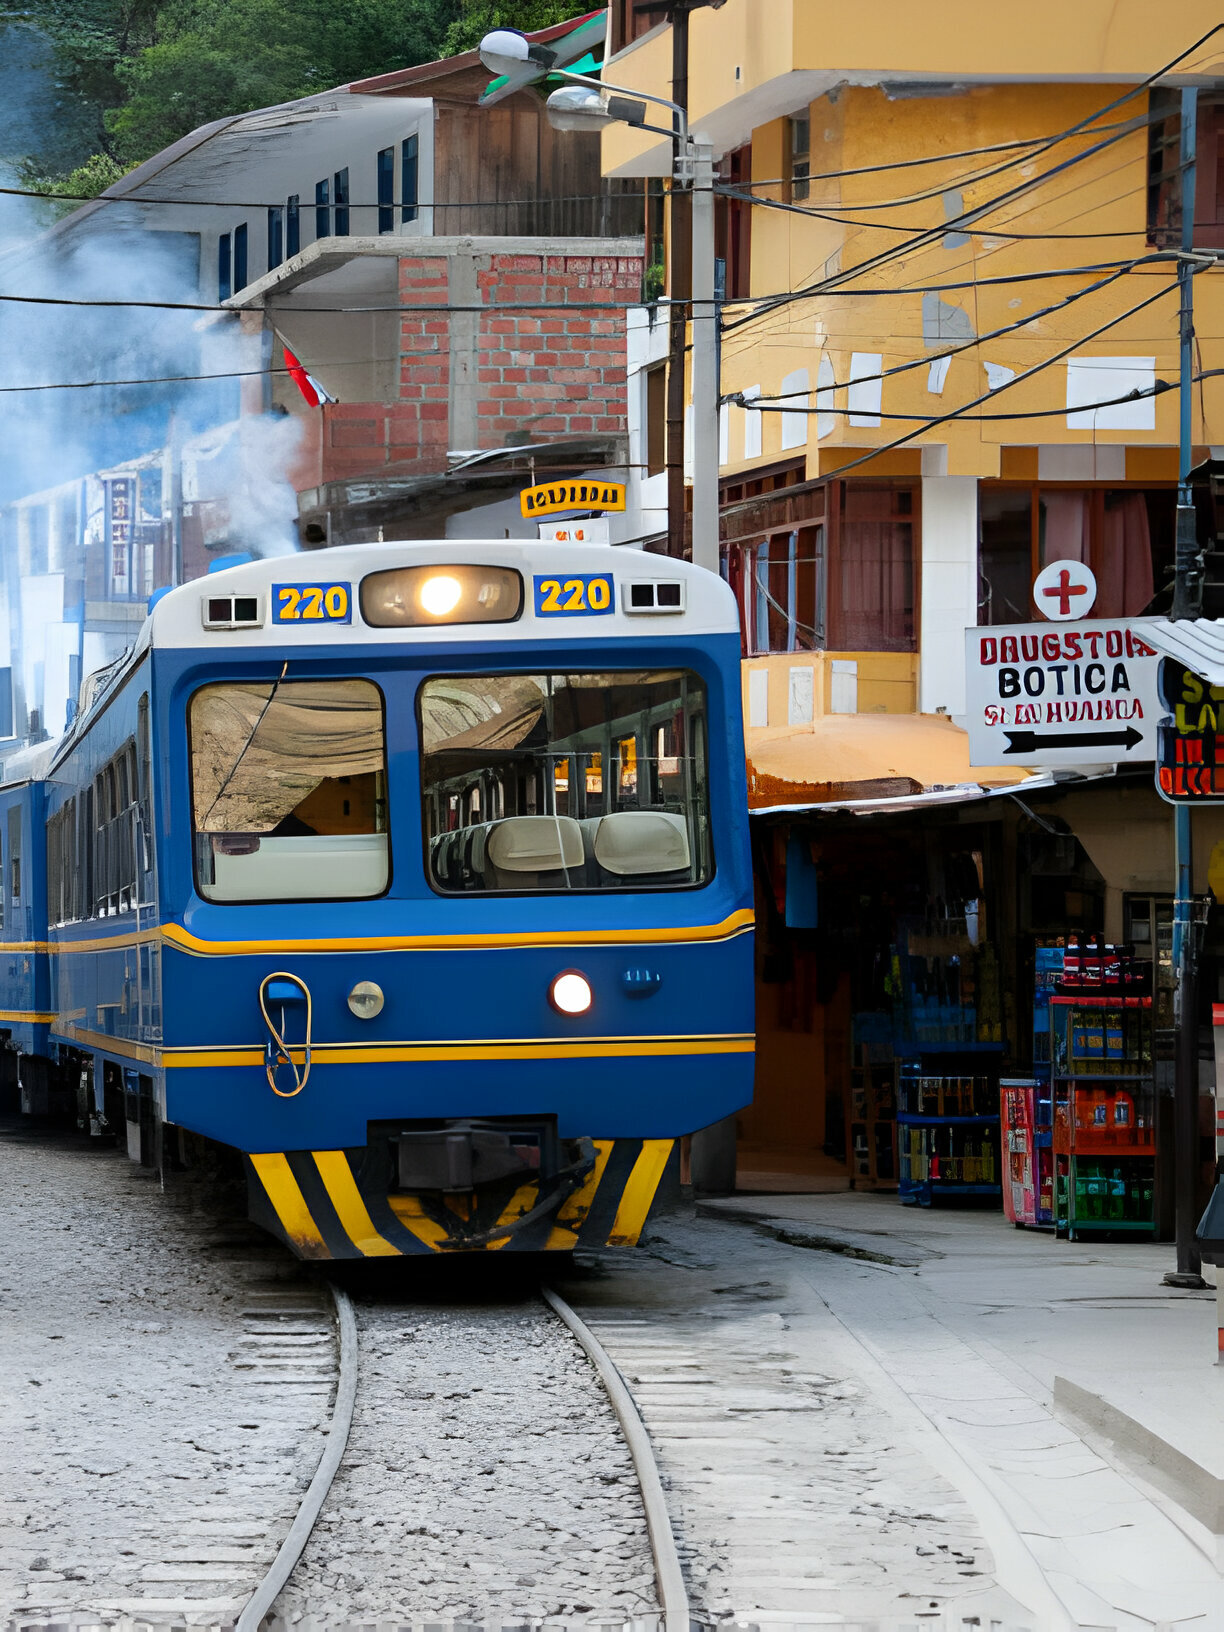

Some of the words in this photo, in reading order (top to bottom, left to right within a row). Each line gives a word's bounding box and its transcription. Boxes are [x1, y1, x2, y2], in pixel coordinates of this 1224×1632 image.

[278, 587, 348, 619] 220
[539, 579, 611, 612] 220
[998, 662, 1131, 698] BOTICA
